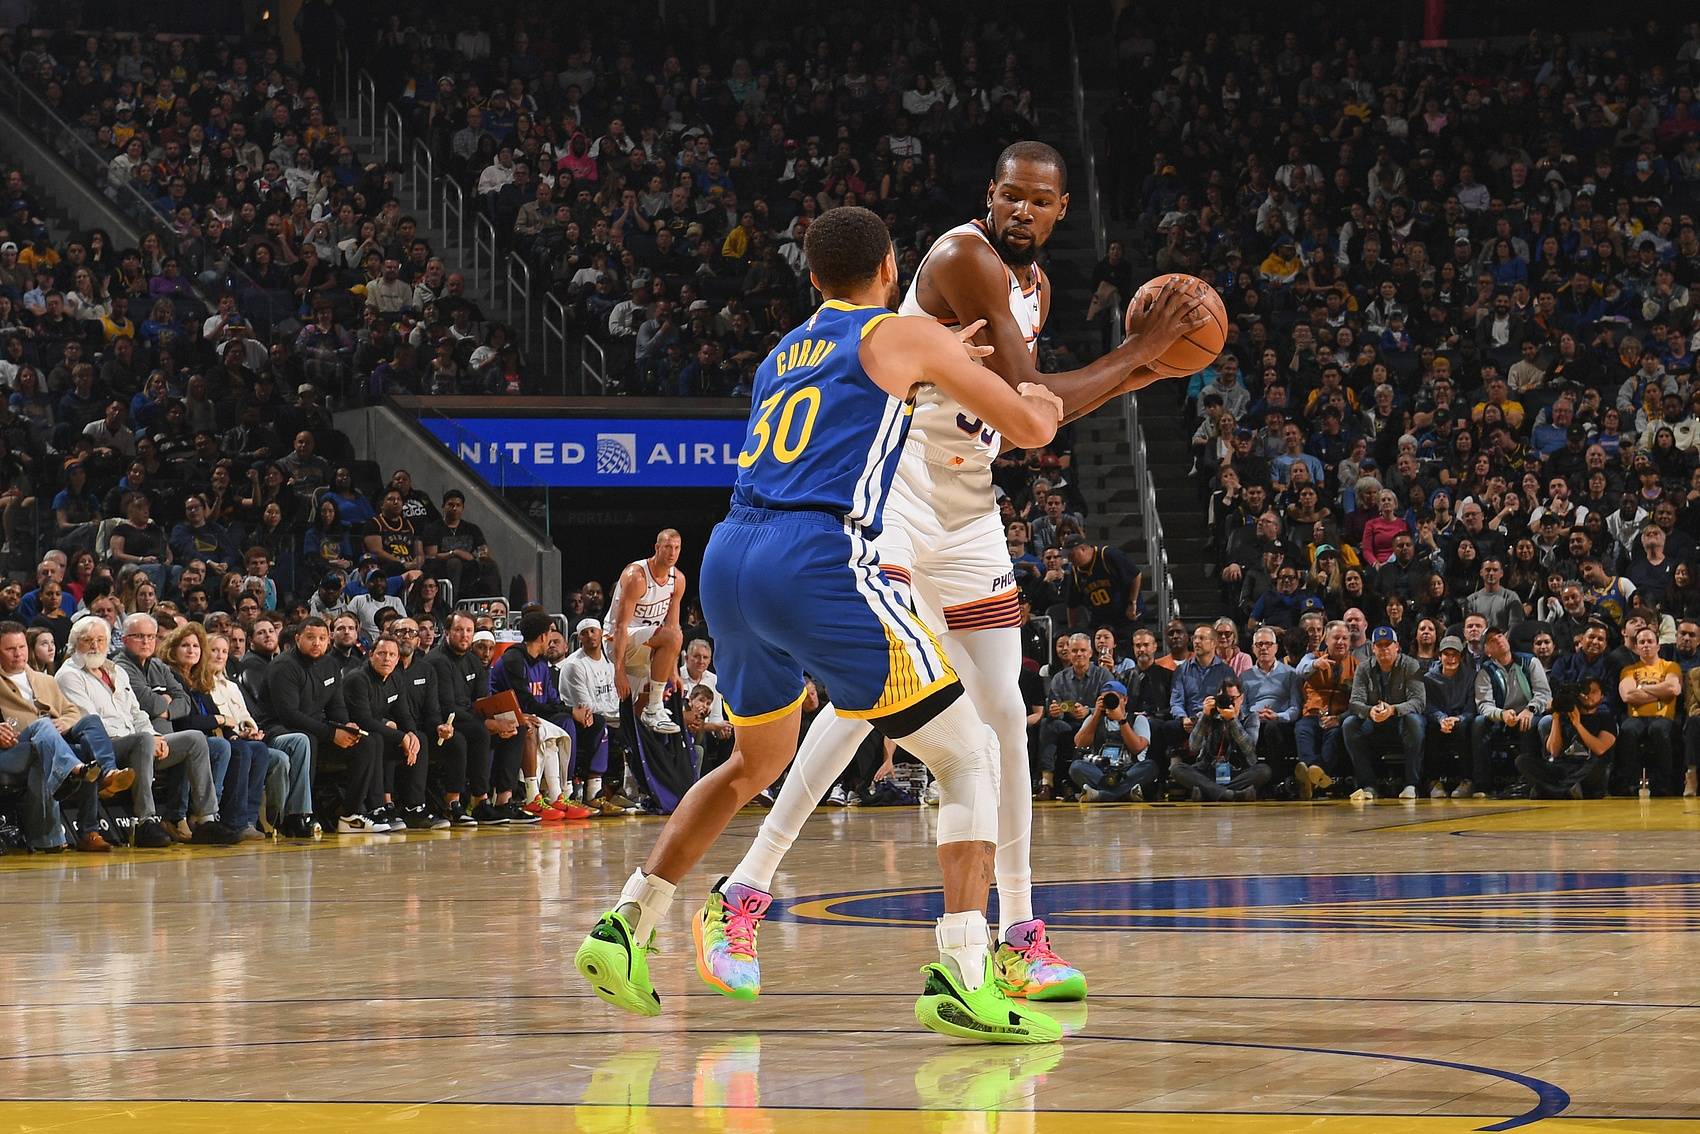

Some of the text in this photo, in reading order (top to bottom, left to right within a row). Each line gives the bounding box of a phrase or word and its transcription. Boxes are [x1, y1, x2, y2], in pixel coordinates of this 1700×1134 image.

[776, 339, 837, 377] CURRY
[738, 386, 821, 468] 30
[444, 442, 739, 464] NITED AIRL
[568, 511, 635, 524] PORTAL A
